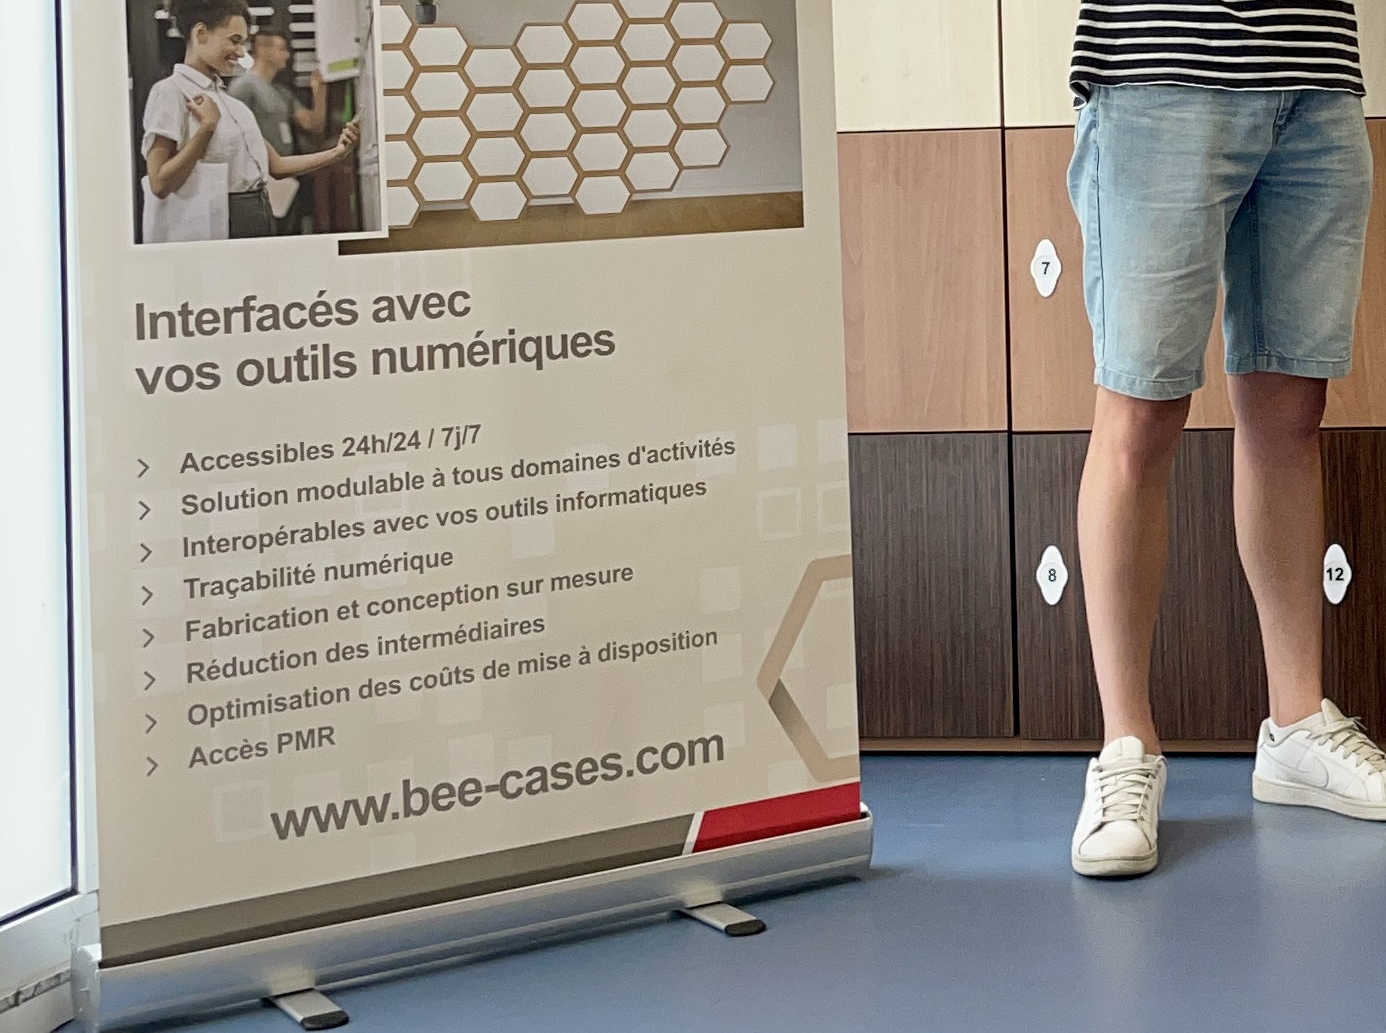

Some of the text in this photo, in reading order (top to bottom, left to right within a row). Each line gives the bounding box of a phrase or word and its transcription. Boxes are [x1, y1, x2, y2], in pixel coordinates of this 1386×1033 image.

[1041, 261, 1051, 275] 7
[135, 289, 472, 341] Interfacés avec
[135, 328, 616, 395] vos outils numériques
[179, 423, 482, 475] Accessibles 24h/24 / 7j/7
[181, 436, 736, 516] Solution modulable à tous domaines d'activités
[183, 481, 707, 558] Interopérables avec vos outils informatiques
[183, 551, 454, 600] Traçabilité numérique
[1048, 568, 1056, 582] 8
[1326, 567, 1345, 581] 12
[185, 567, 634, 642] Fabrication et conception sur mesure
[186, 617, 546, 684] Réduction des intermédiaires
[187, 630, 718, 729] Optimisation des coûts de mise à disposition
[188, 725, 336, 769] Accès PMR
[269, 734, 725, 841] www.bee-cases.com
